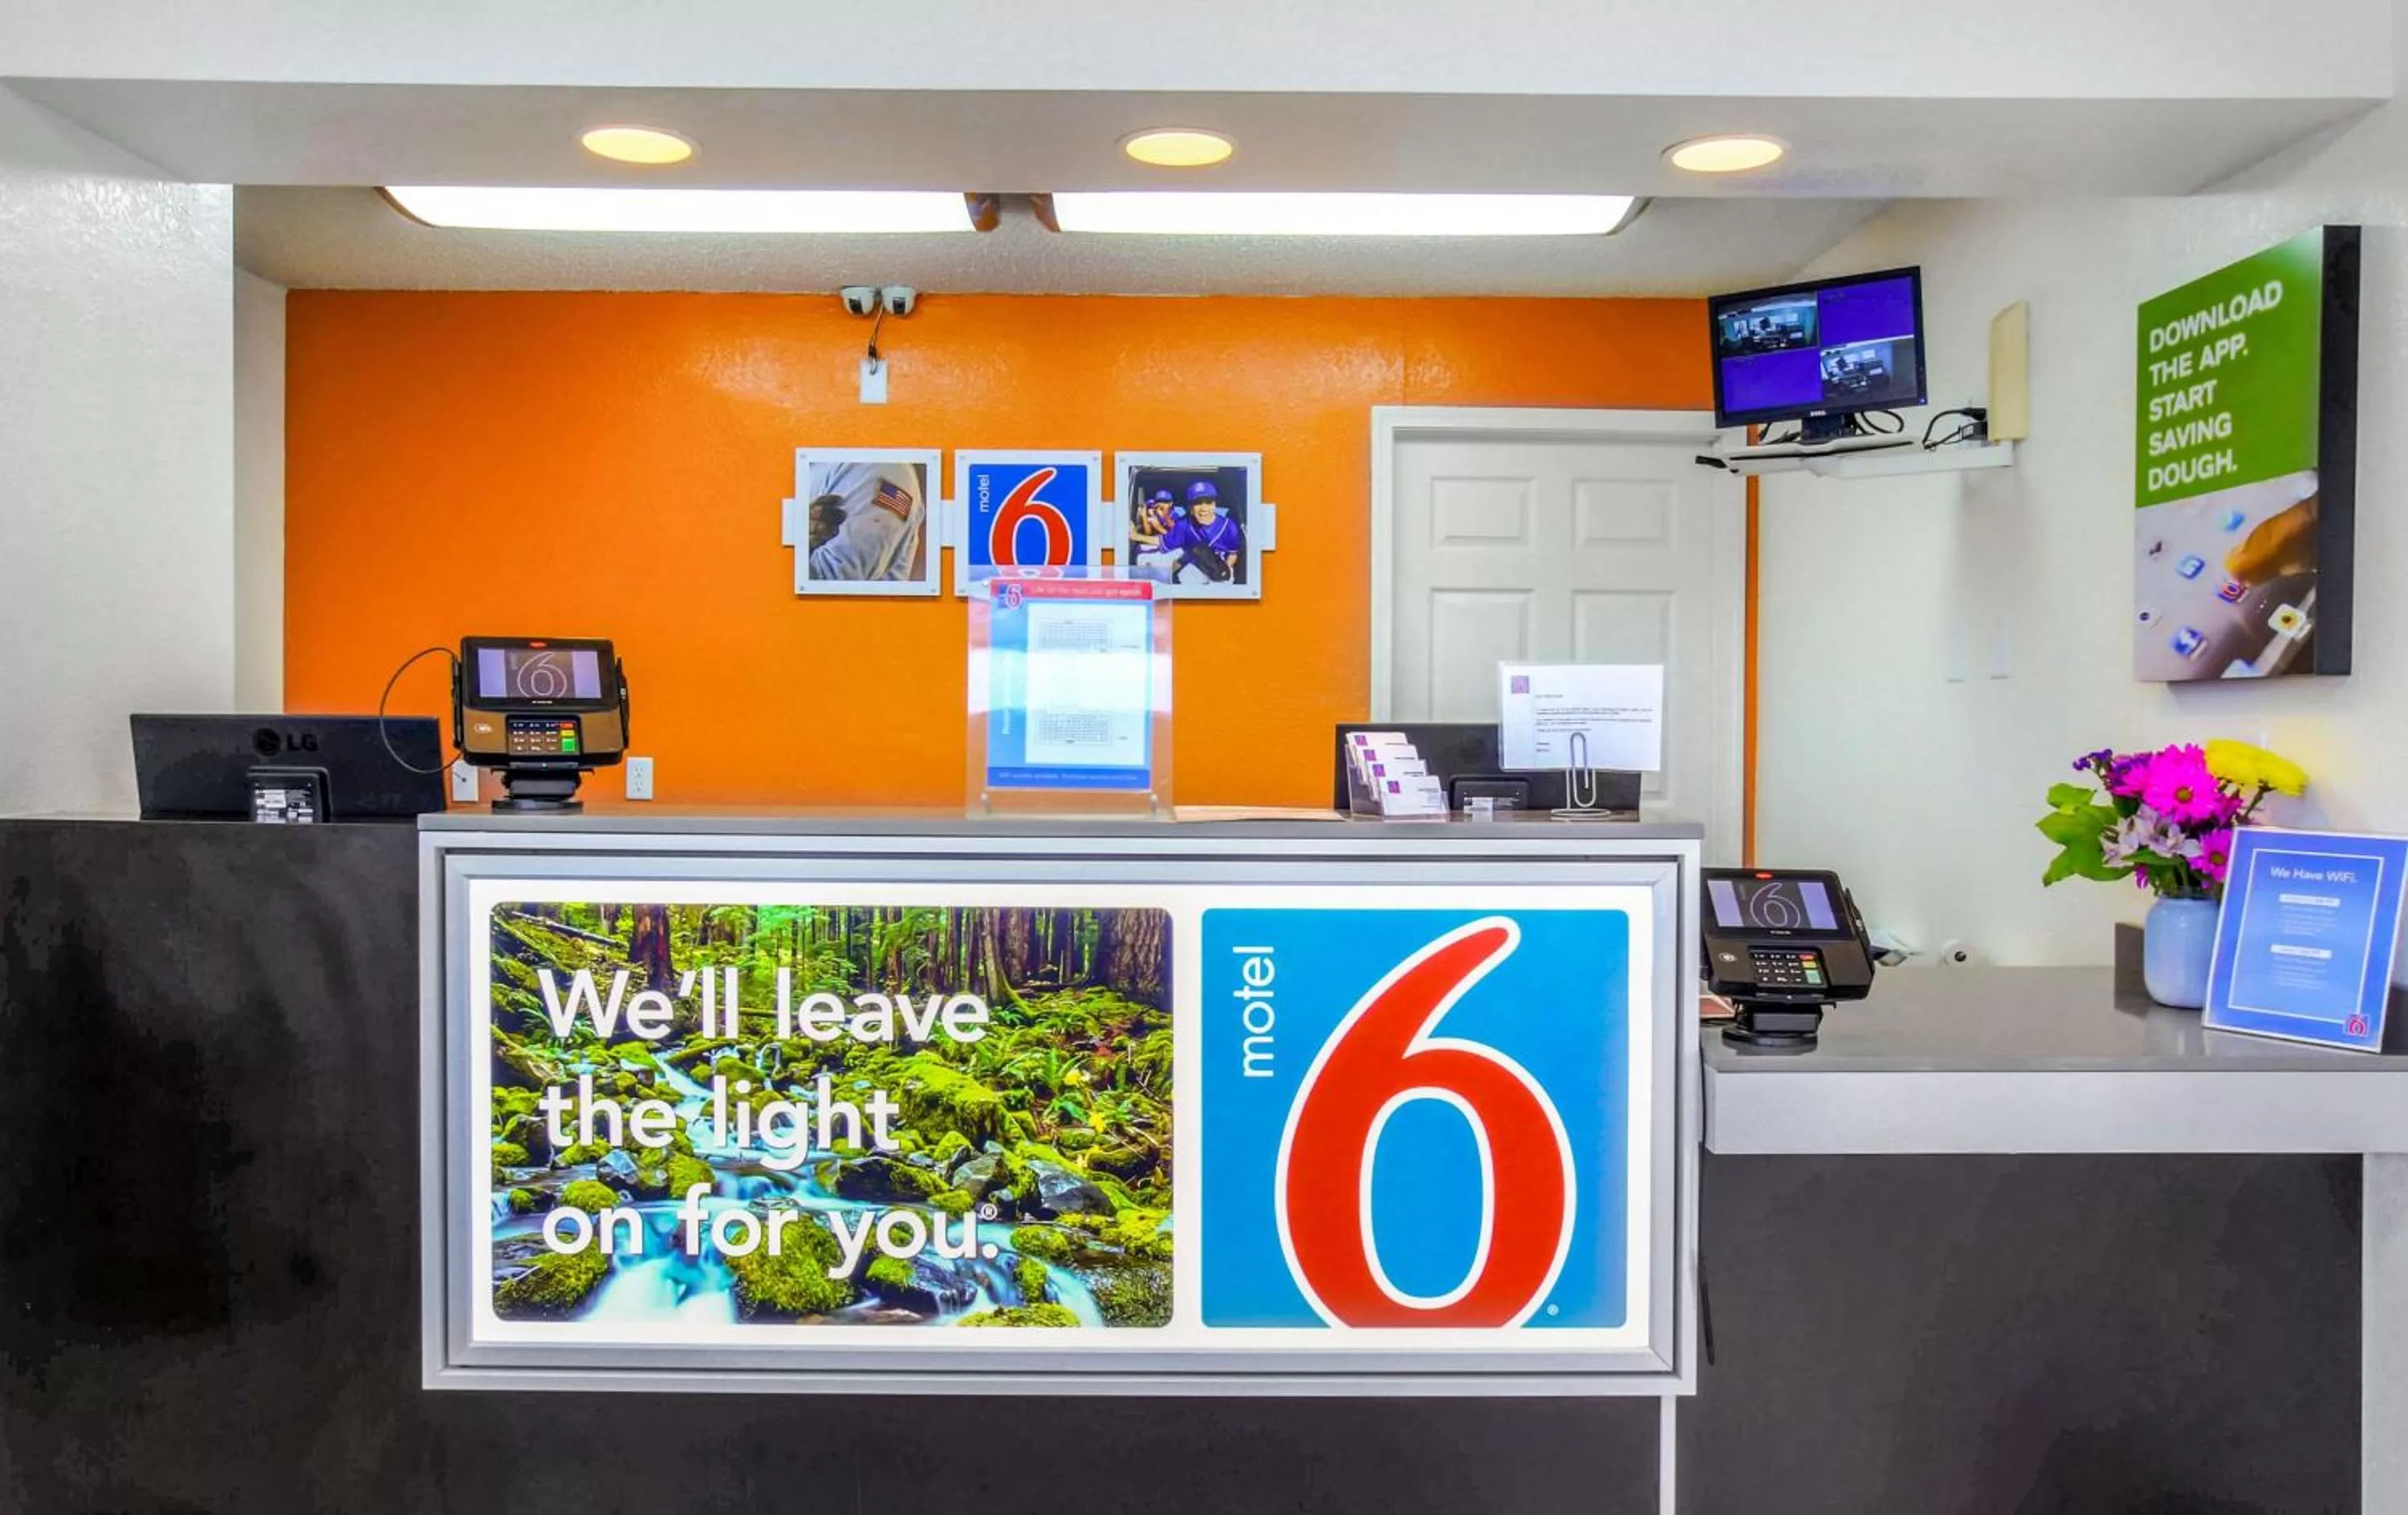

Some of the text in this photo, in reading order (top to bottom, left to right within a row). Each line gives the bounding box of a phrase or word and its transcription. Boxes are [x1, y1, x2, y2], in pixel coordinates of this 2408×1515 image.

[2149, 280, 2284, 353] DOWNLOAD
[2149, 332, 2248, 387] THE APP.
[2149, 379, 2218, 422] START
[2149, 412, 2231, 457] SAVING
[977, 474, 990, 513] motel
[2148, 449, 2238, 491] DOUGH.
[989, 467, 1073, 579] 6
[517, 651, 568, 698] 6
[287, 732, 319, 752] LG
[2270, 867, 2291, 879] We
[1750, 882, 1801, 928] 6
[777, 966, 990, 1042] leave
[1232, 945, 1275, 1078] motel
[539, 1074, 900, 1171] the light
[1274, 915, 1577, 1329] 6
[542, 1205, 641, 1256] on
[677, 1182, 799, 1257] for
